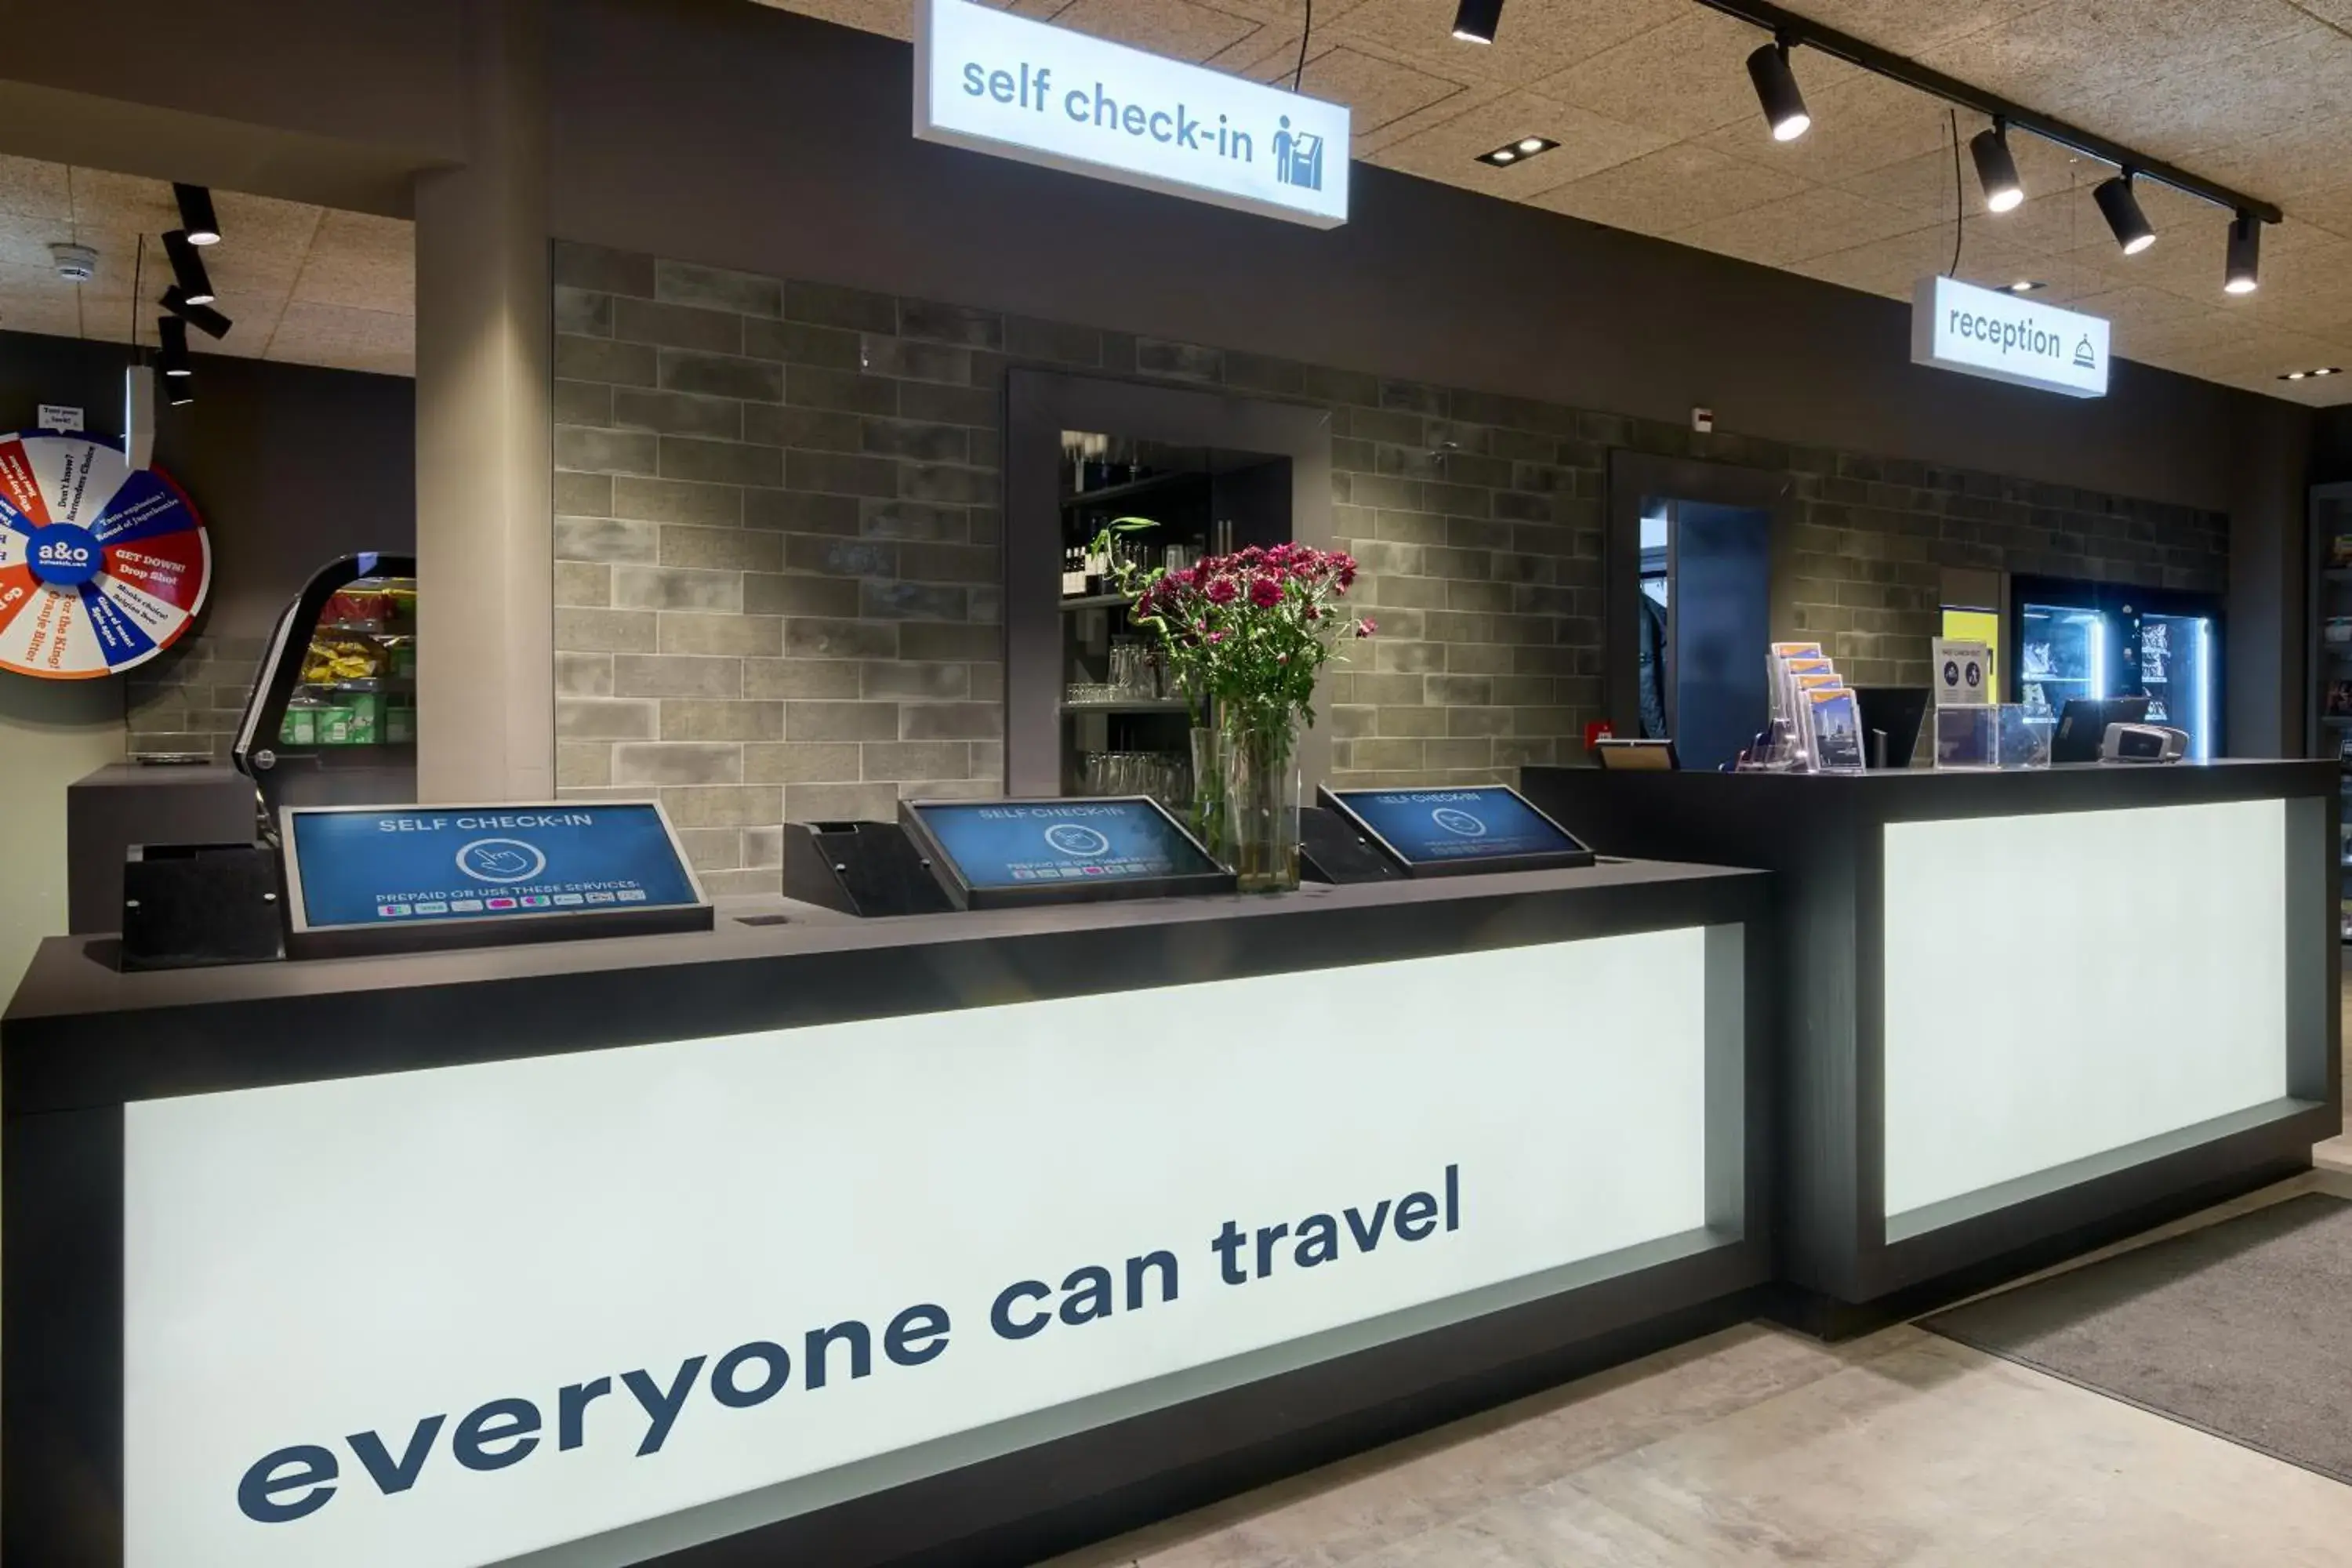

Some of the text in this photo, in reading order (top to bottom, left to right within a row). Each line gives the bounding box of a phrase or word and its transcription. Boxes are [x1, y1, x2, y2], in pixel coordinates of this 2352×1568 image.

[963, 62, 1253, 163] self check-in
[1950, 309, 2060, 358] reception
[58, 454, 74, 508] Don't know?
[67, 475, 87, 521] Bartenders
[39, 541, 89, 561] a&o
[115, 549, 187, 573] GET DOWN!
[119, 564, 177, 585] Drop Shot
[26, 590, 60, 662] Oranje Bitter
[47, 593, 77, 669] For the King!
[379, 814, 593, 833] SELF CHECK-IN
[978, 806, 1126, 820] SELF CHECK-IN
[376, 891, 446, 902] PREPAID
[451, 889, 474, 899] OR
[478, 886, 510, 897] USE
[511, 884, 562, 895] THESE
[238, 1163, 1459, 1523] everyone can travel
